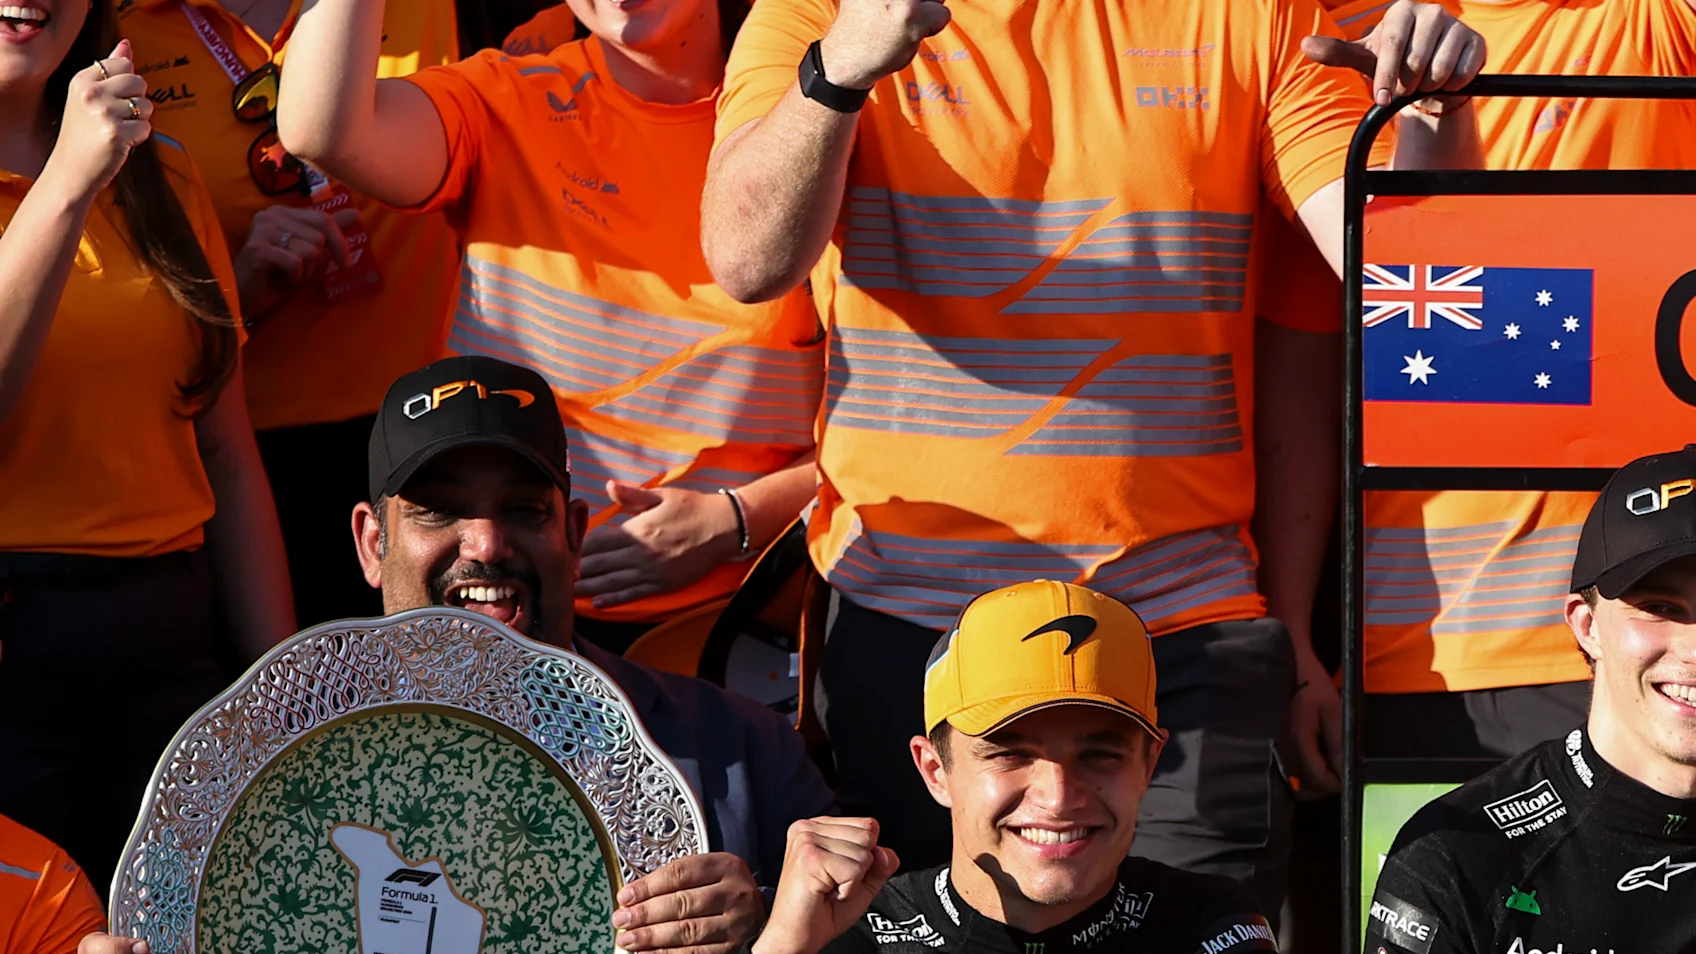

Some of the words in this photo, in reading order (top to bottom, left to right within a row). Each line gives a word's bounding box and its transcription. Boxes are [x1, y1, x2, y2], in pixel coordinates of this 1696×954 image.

[148, 83, 196, 104] ELL
[1492, 790, 1555, 823] Hilton
[1505, 826, 1526, 839] FOR
[1524, 818, 1547, 833] THE
[1544, 806, 1568, 824] STAY
[382, 886, 429, 903] Formula
